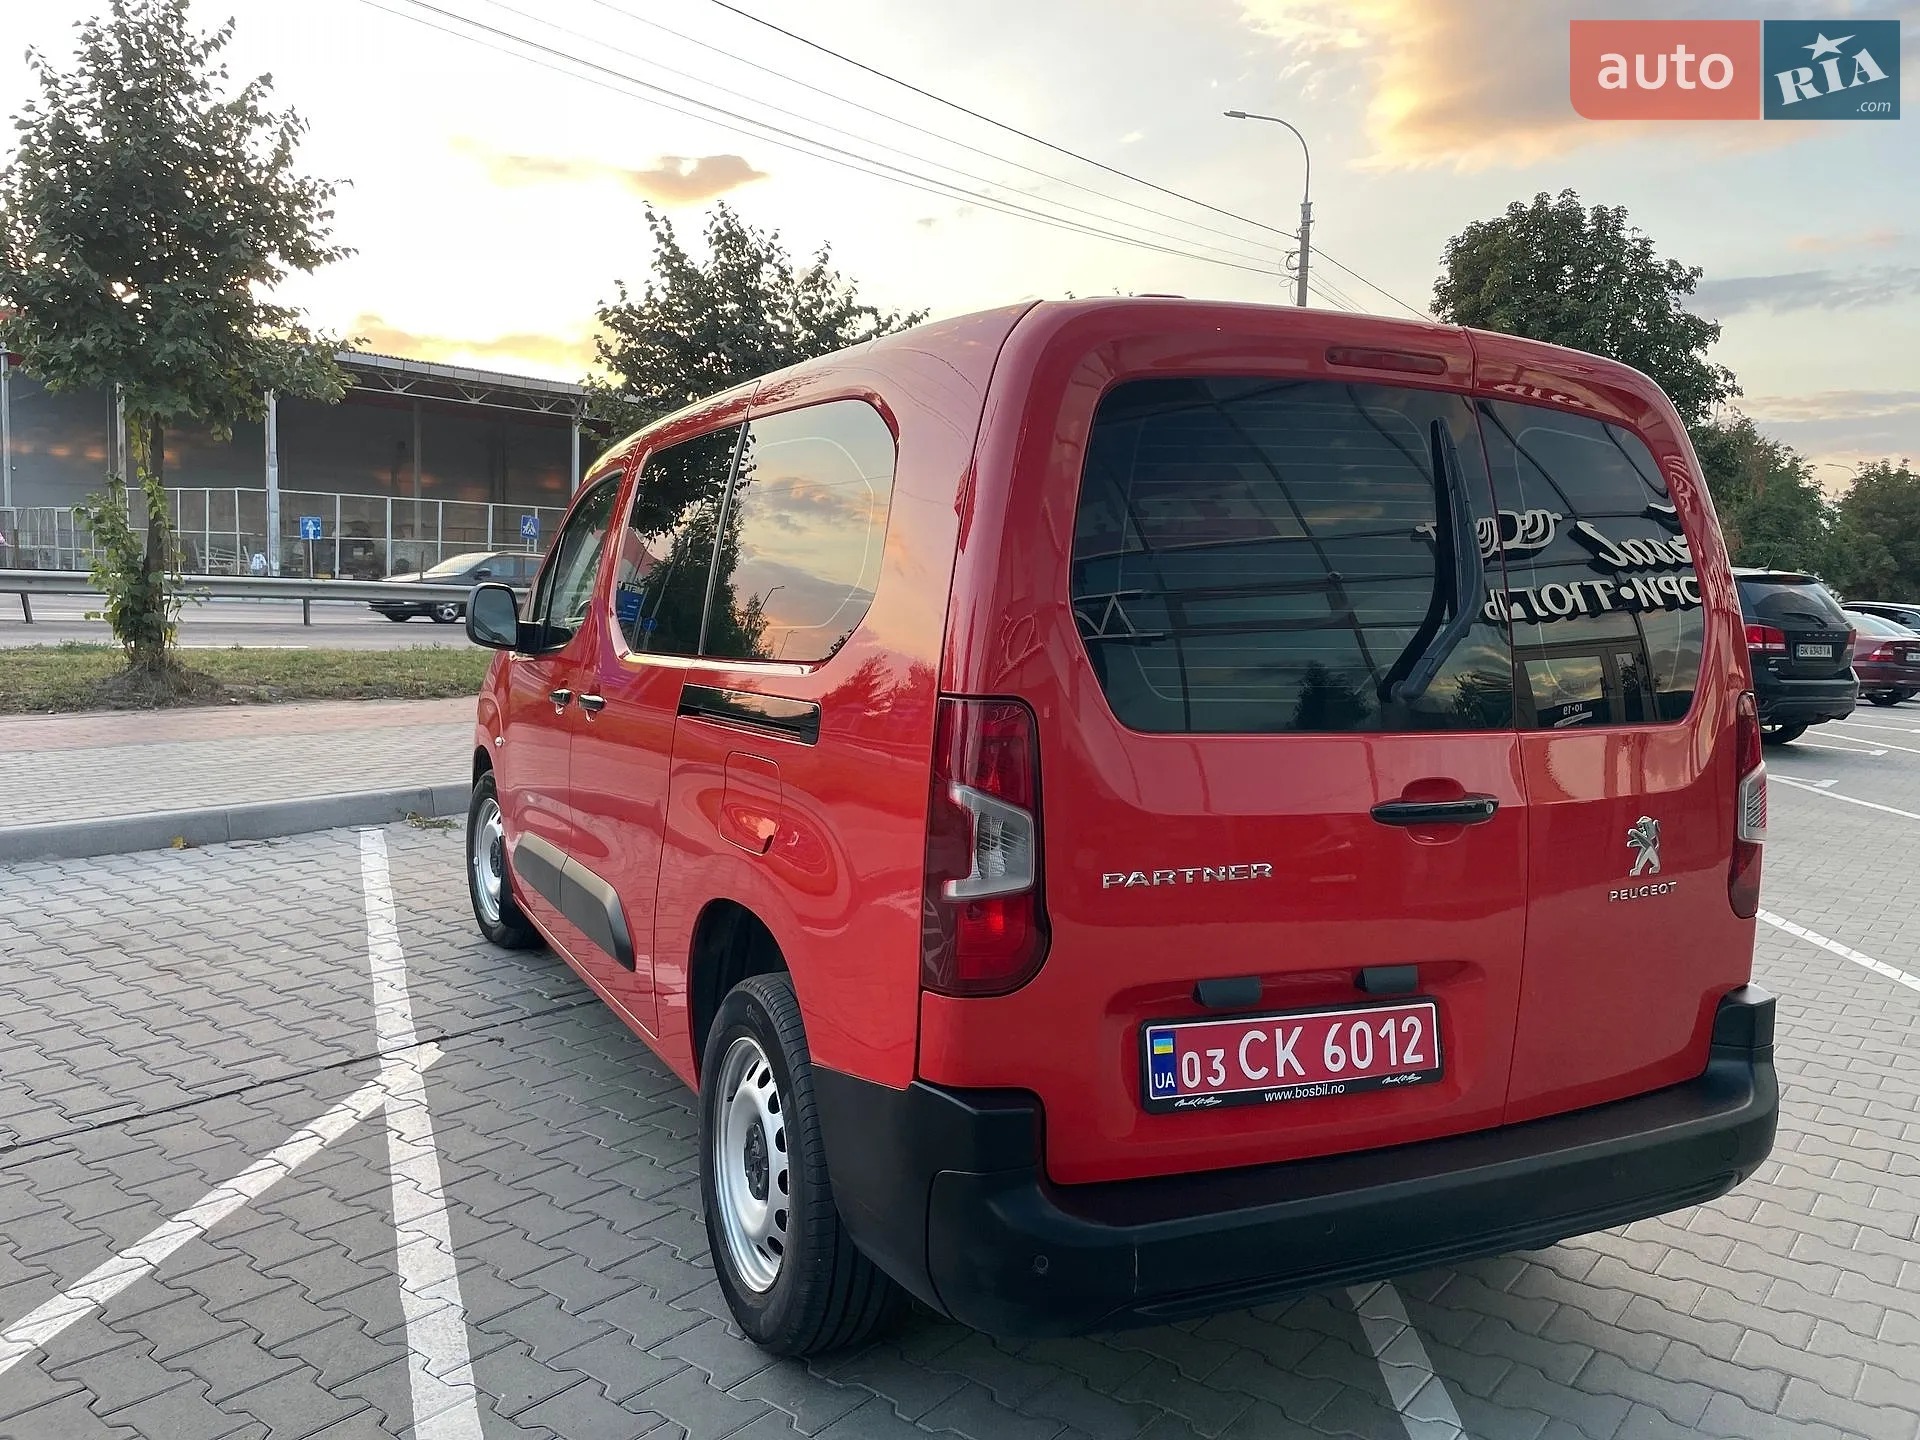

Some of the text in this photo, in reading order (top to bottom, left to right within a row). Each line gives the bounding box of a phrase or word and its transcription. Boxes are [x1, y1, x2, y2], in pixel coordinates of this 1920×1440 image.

[1102, 862, 1273, 889] PARTNER
[1608, 881, 1677, 902] PEUGEOT
[1182, 1015, 1424, 1089] 03 CK 6012
[1155, 1071, 1176, 1089] UA
[1264, 1083, 1345, 1102] www.bosbil.no
